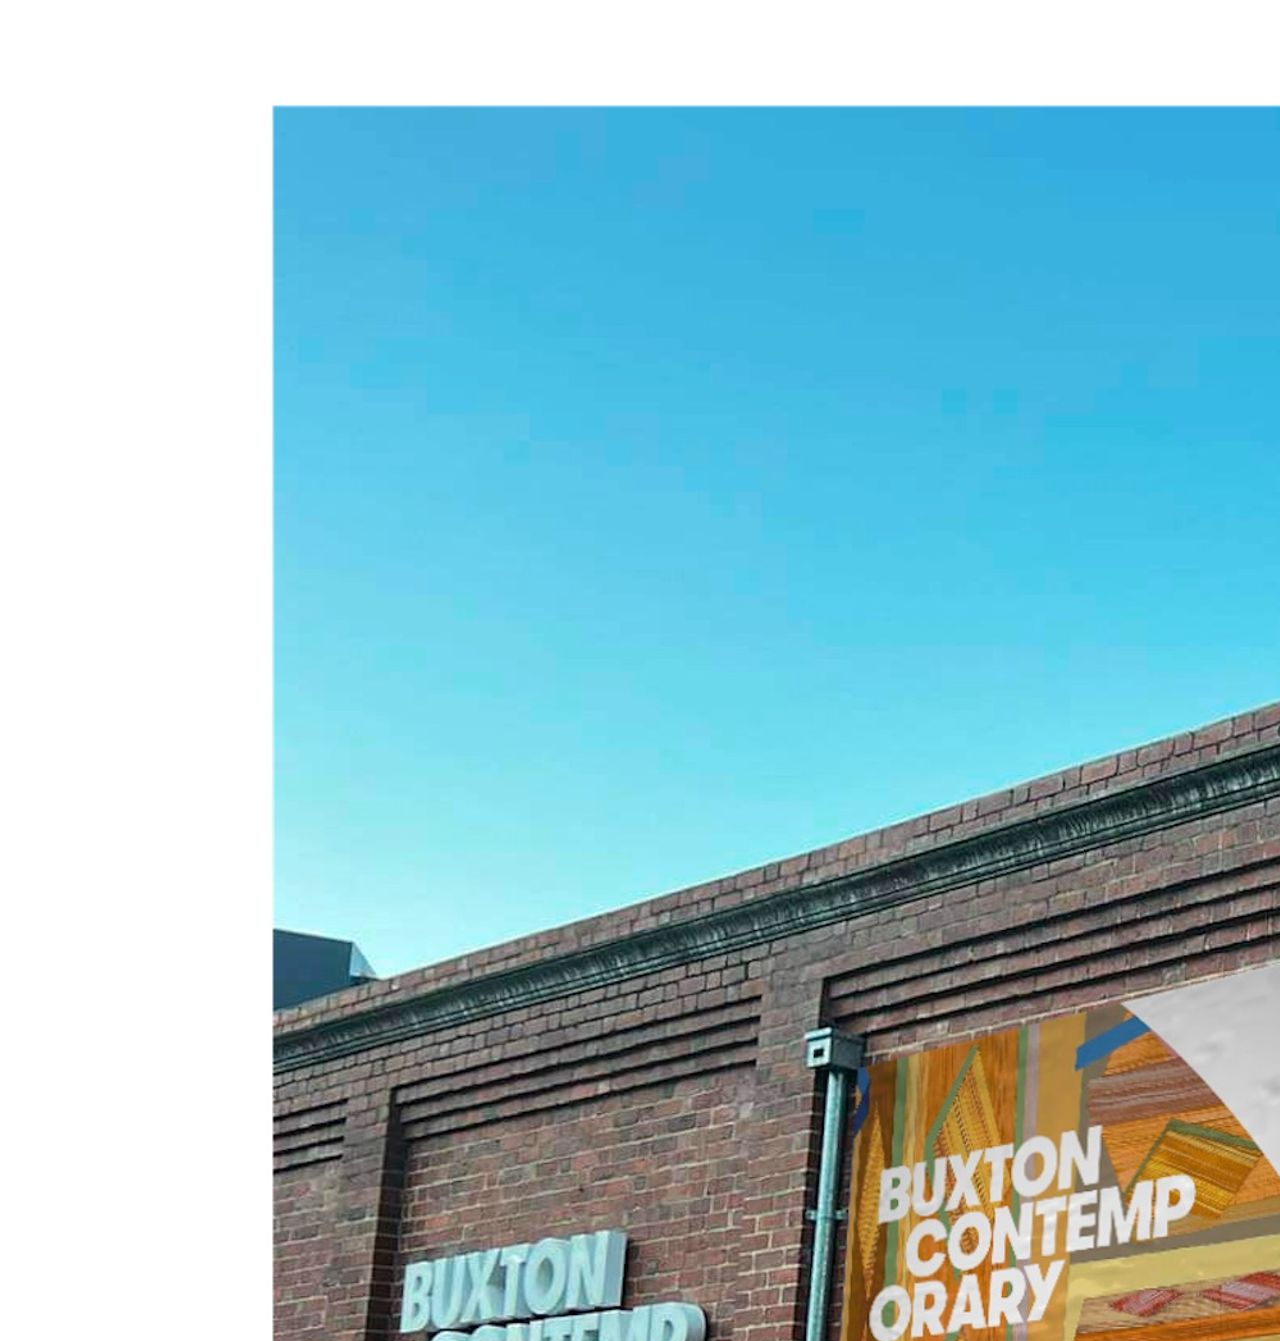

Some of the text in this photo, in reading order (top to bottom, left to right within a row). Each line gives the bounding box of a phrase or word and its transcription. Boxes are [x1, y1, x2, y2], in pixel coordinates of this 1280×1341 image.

[878, 1126, 1102, 1224] BUXTON
[905, 1174, 1195, 1276] CONTEMP
[401, 1230, 627, 1333] BUXTON
